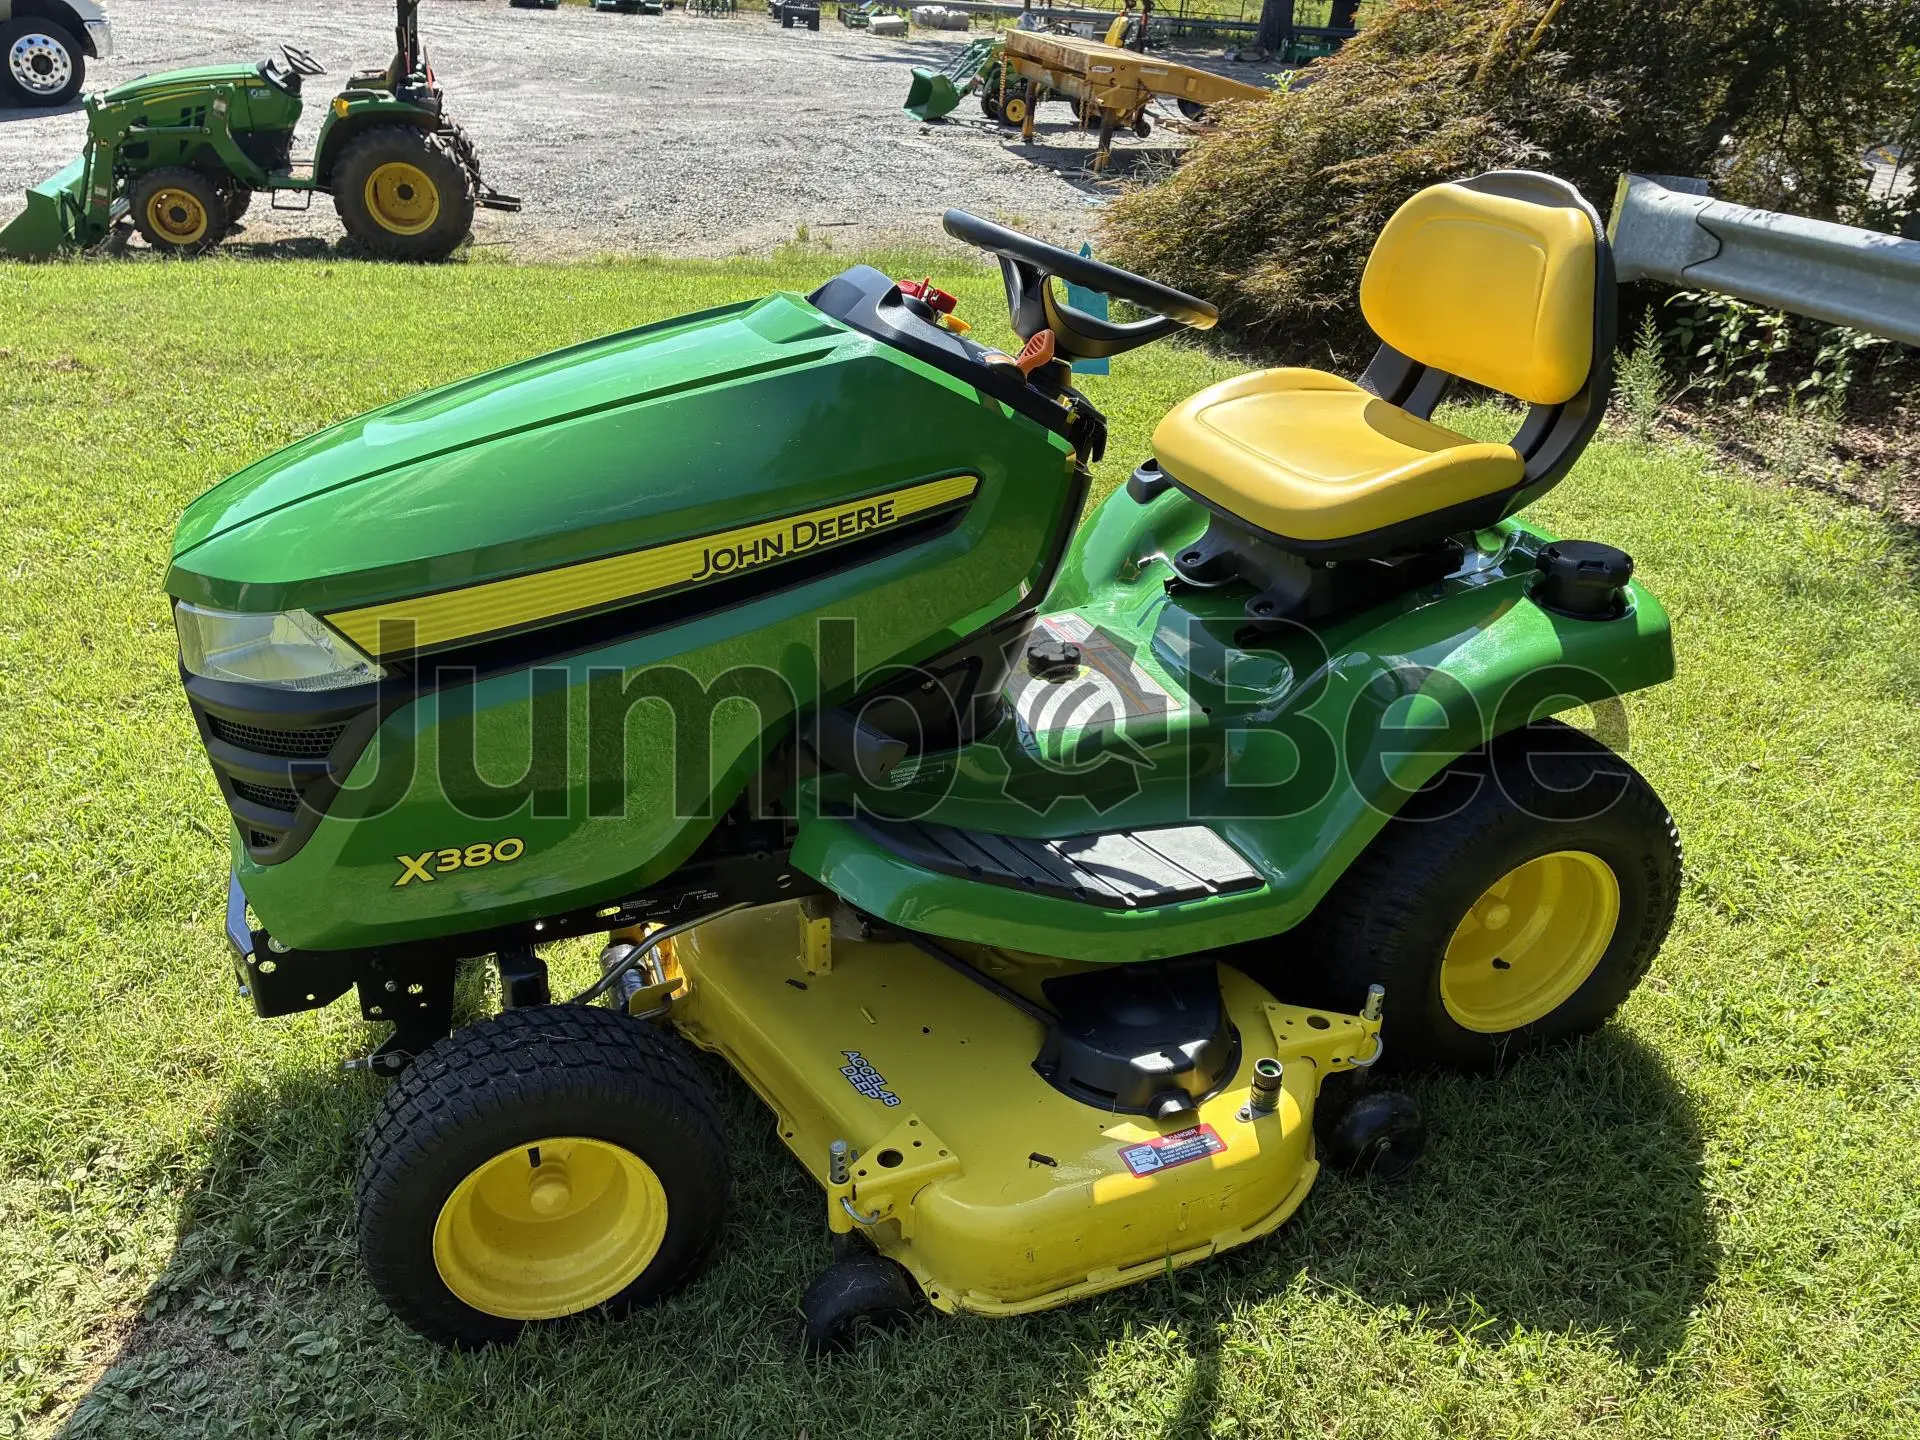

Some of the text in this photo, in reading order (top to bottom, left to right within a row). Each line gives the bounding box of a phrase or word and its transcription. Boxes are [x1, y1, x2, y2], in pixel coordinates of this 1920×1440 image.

[692, 500, 896, 579] JOHN DEERE
[392, 836, 526, 888] X380
[839, 1065, 880, 1100] DEEP
[840, 1051, 887, 1091] ACCEL
[877, 1090, 902, 1107] 48
[1168, 1128, 1198, 1141] DANGER
